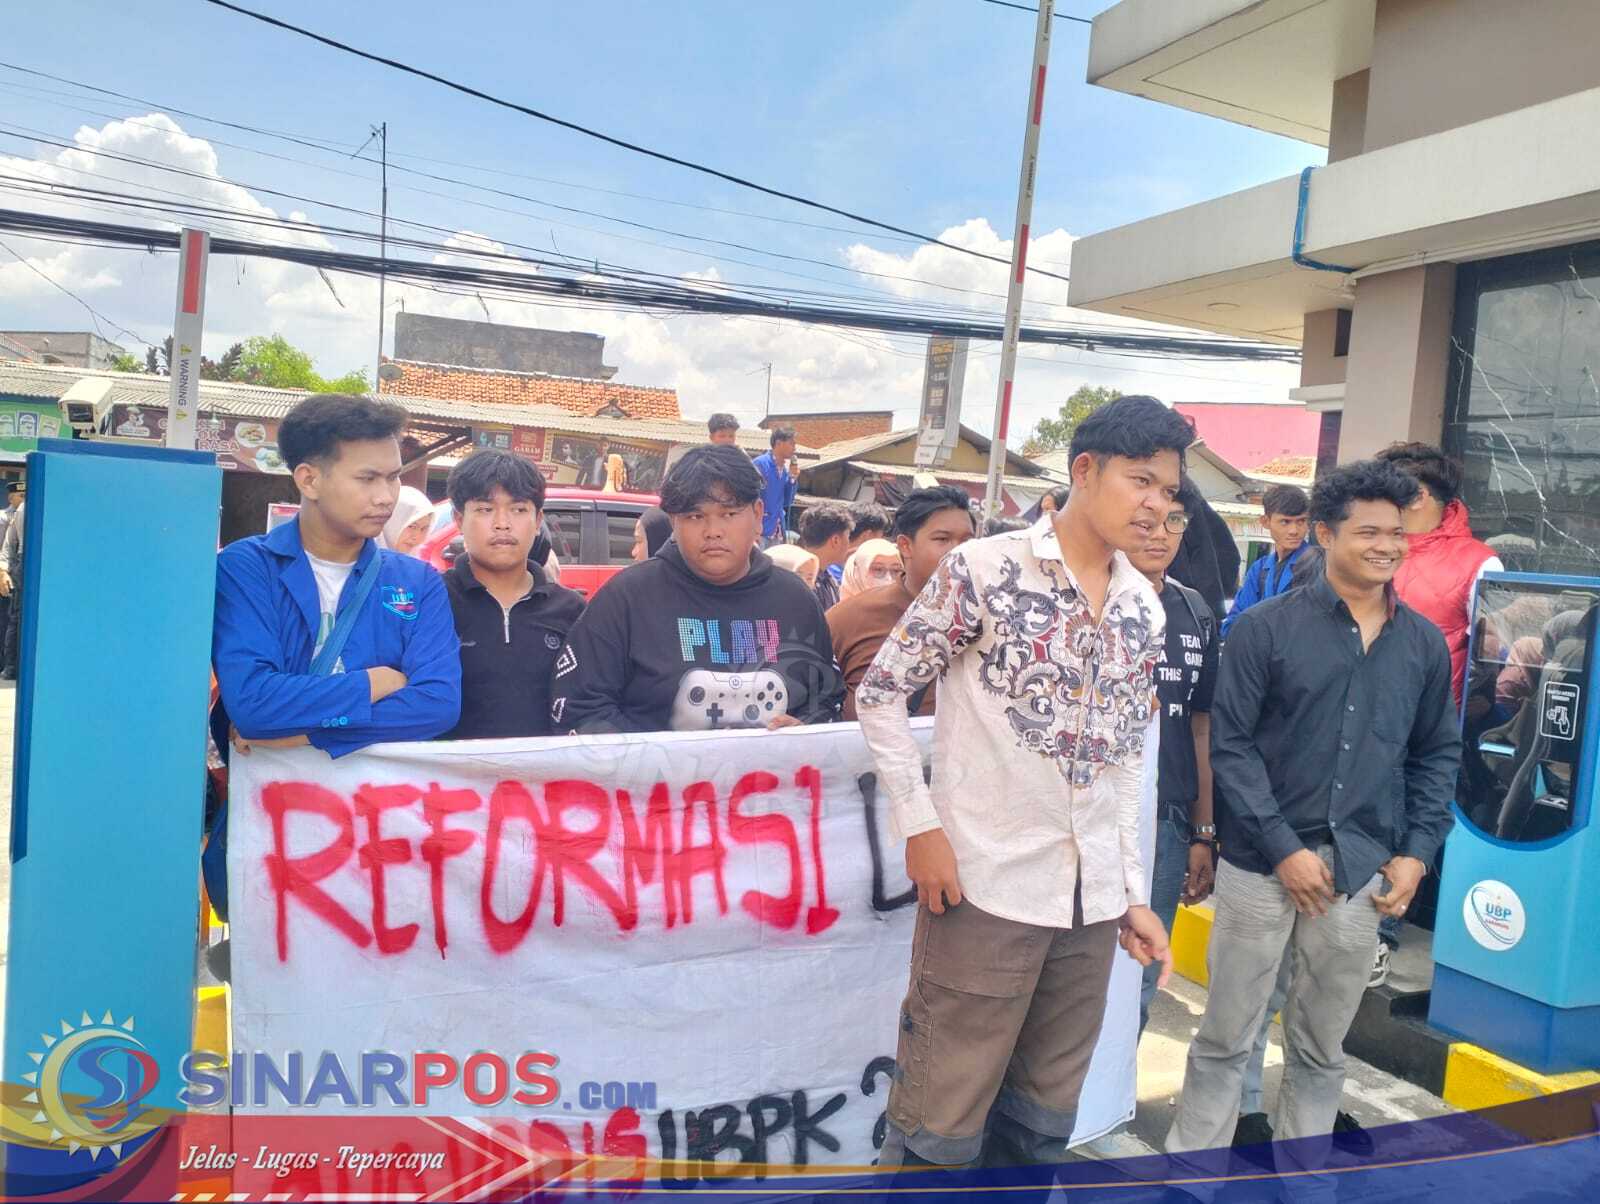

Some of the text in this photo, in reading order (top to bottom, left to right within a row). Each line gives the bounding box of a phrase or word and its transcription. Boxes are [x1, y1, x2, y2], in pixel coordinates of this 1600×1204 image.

[178, 358, 190, 407] WARNING
[677, 617, 781, 664] PLAY
[1158, 667, 1182, 681] THIS
[261, 765, 842, 963] REFORMASI
[1485, 902, 1512, 918] UBP
